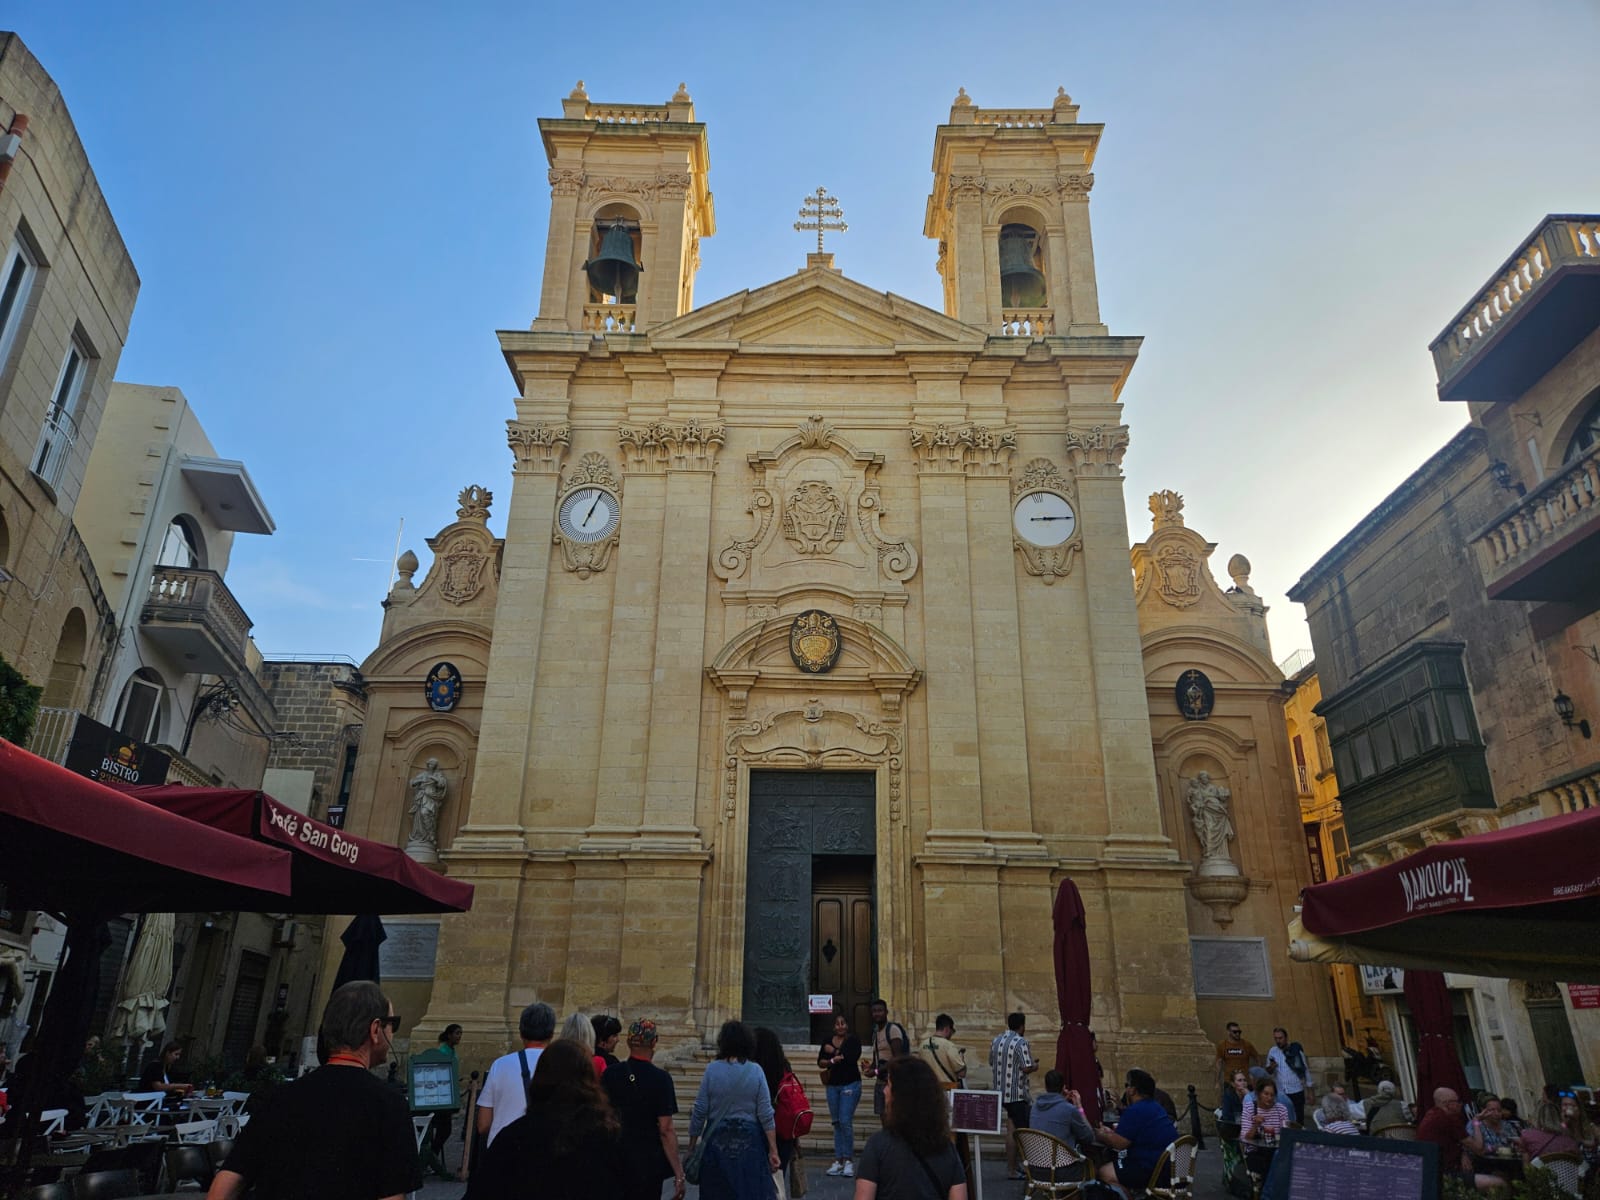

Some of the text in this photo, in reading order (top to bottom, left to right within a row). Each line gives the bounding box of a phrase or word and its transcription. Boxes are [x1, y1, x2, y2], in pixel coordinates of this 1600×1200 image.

[101, 757, 139, 783] BISTRO
[299, 821, 328, 849] San
[1398, 856, 1475, 913] MANOUCHE
